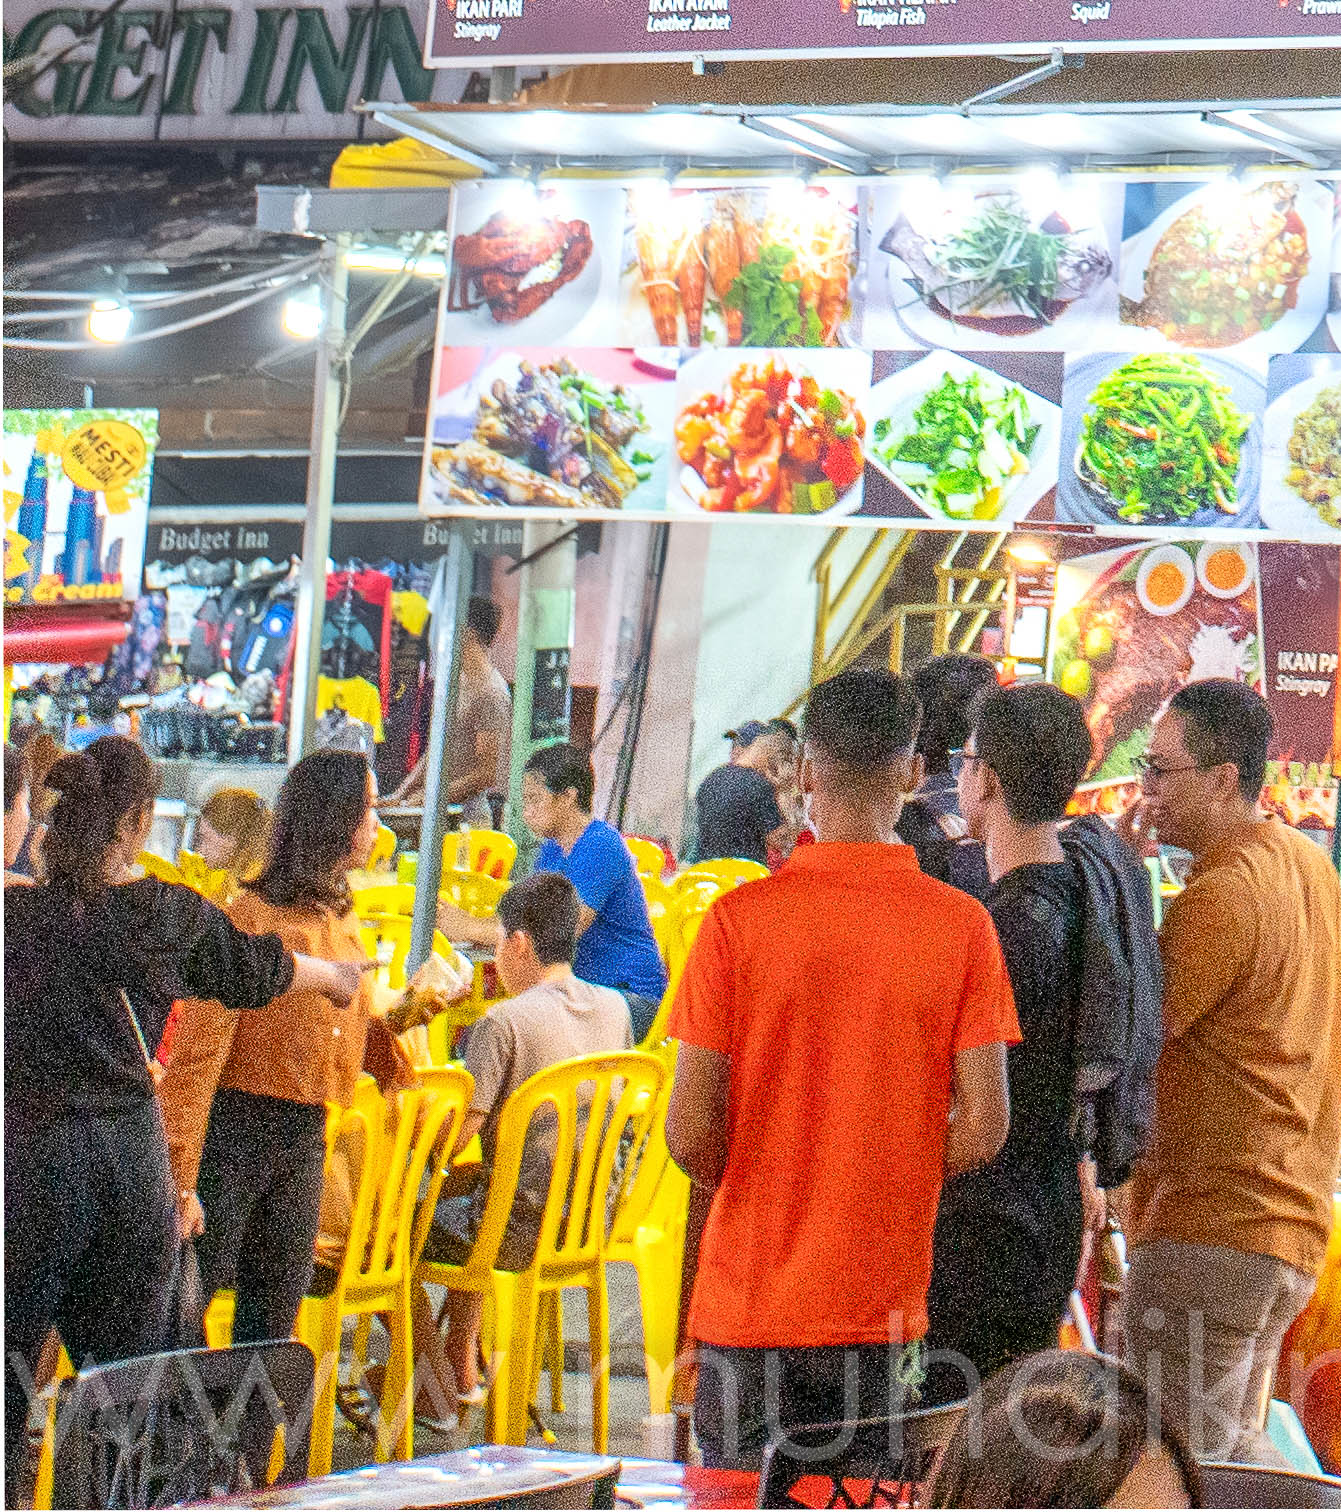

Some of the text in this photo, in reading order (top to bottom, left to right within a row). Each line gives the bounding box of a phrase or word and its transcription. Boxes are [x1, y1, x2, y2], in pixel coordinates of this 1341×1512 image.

[456, 0, 489, 19] IKAN
[856, 7, 927, 30] Tilapia Fish
[1071, 2, 1111, 24] Squid
[454, 22, 501, 42] Stingray
[647, 14, 732, 33] Leather Jacket
[4, 7, 436, 119] GET INN
[160, 527, 269, 554] Budget Inn
[1277, 651, 1317, 672] IKAN
